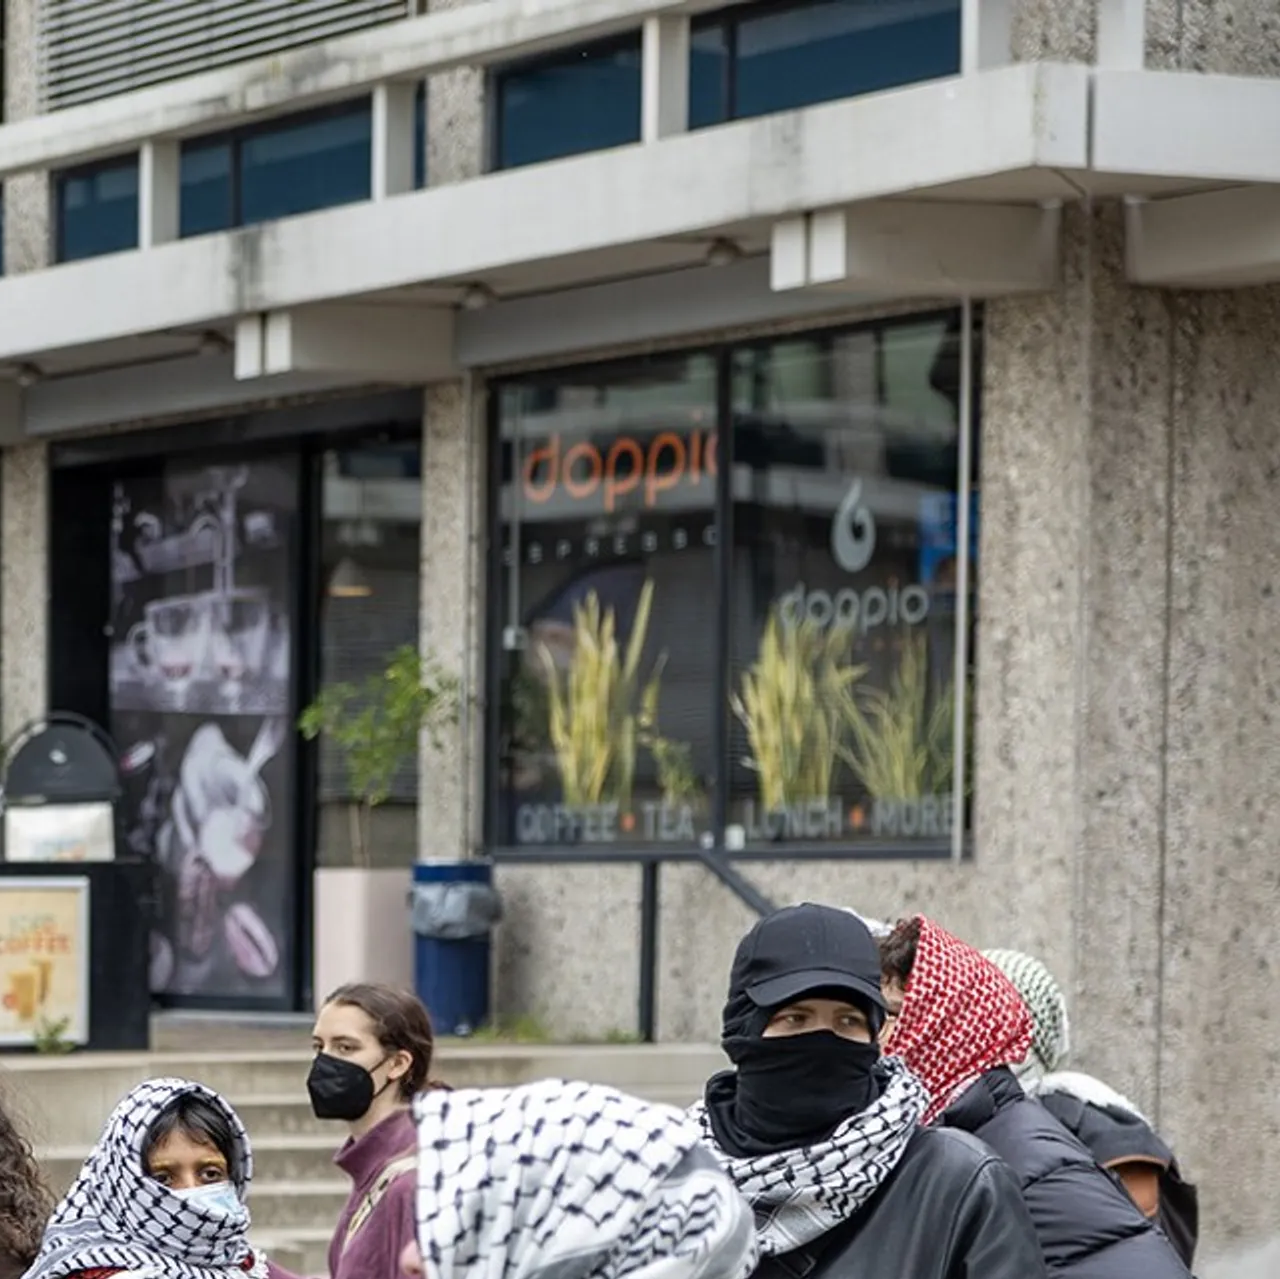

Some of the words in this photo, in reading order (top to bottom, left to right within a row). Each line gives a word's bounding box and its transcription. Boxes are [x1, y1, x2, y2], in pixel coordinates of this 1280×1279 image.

[779, 577, 930, 636] doppio
[517, 801, 619, 843] COFFEE
[641, 800, 695, 842] TEA
[743, 795, 843, 839] LUNCH
